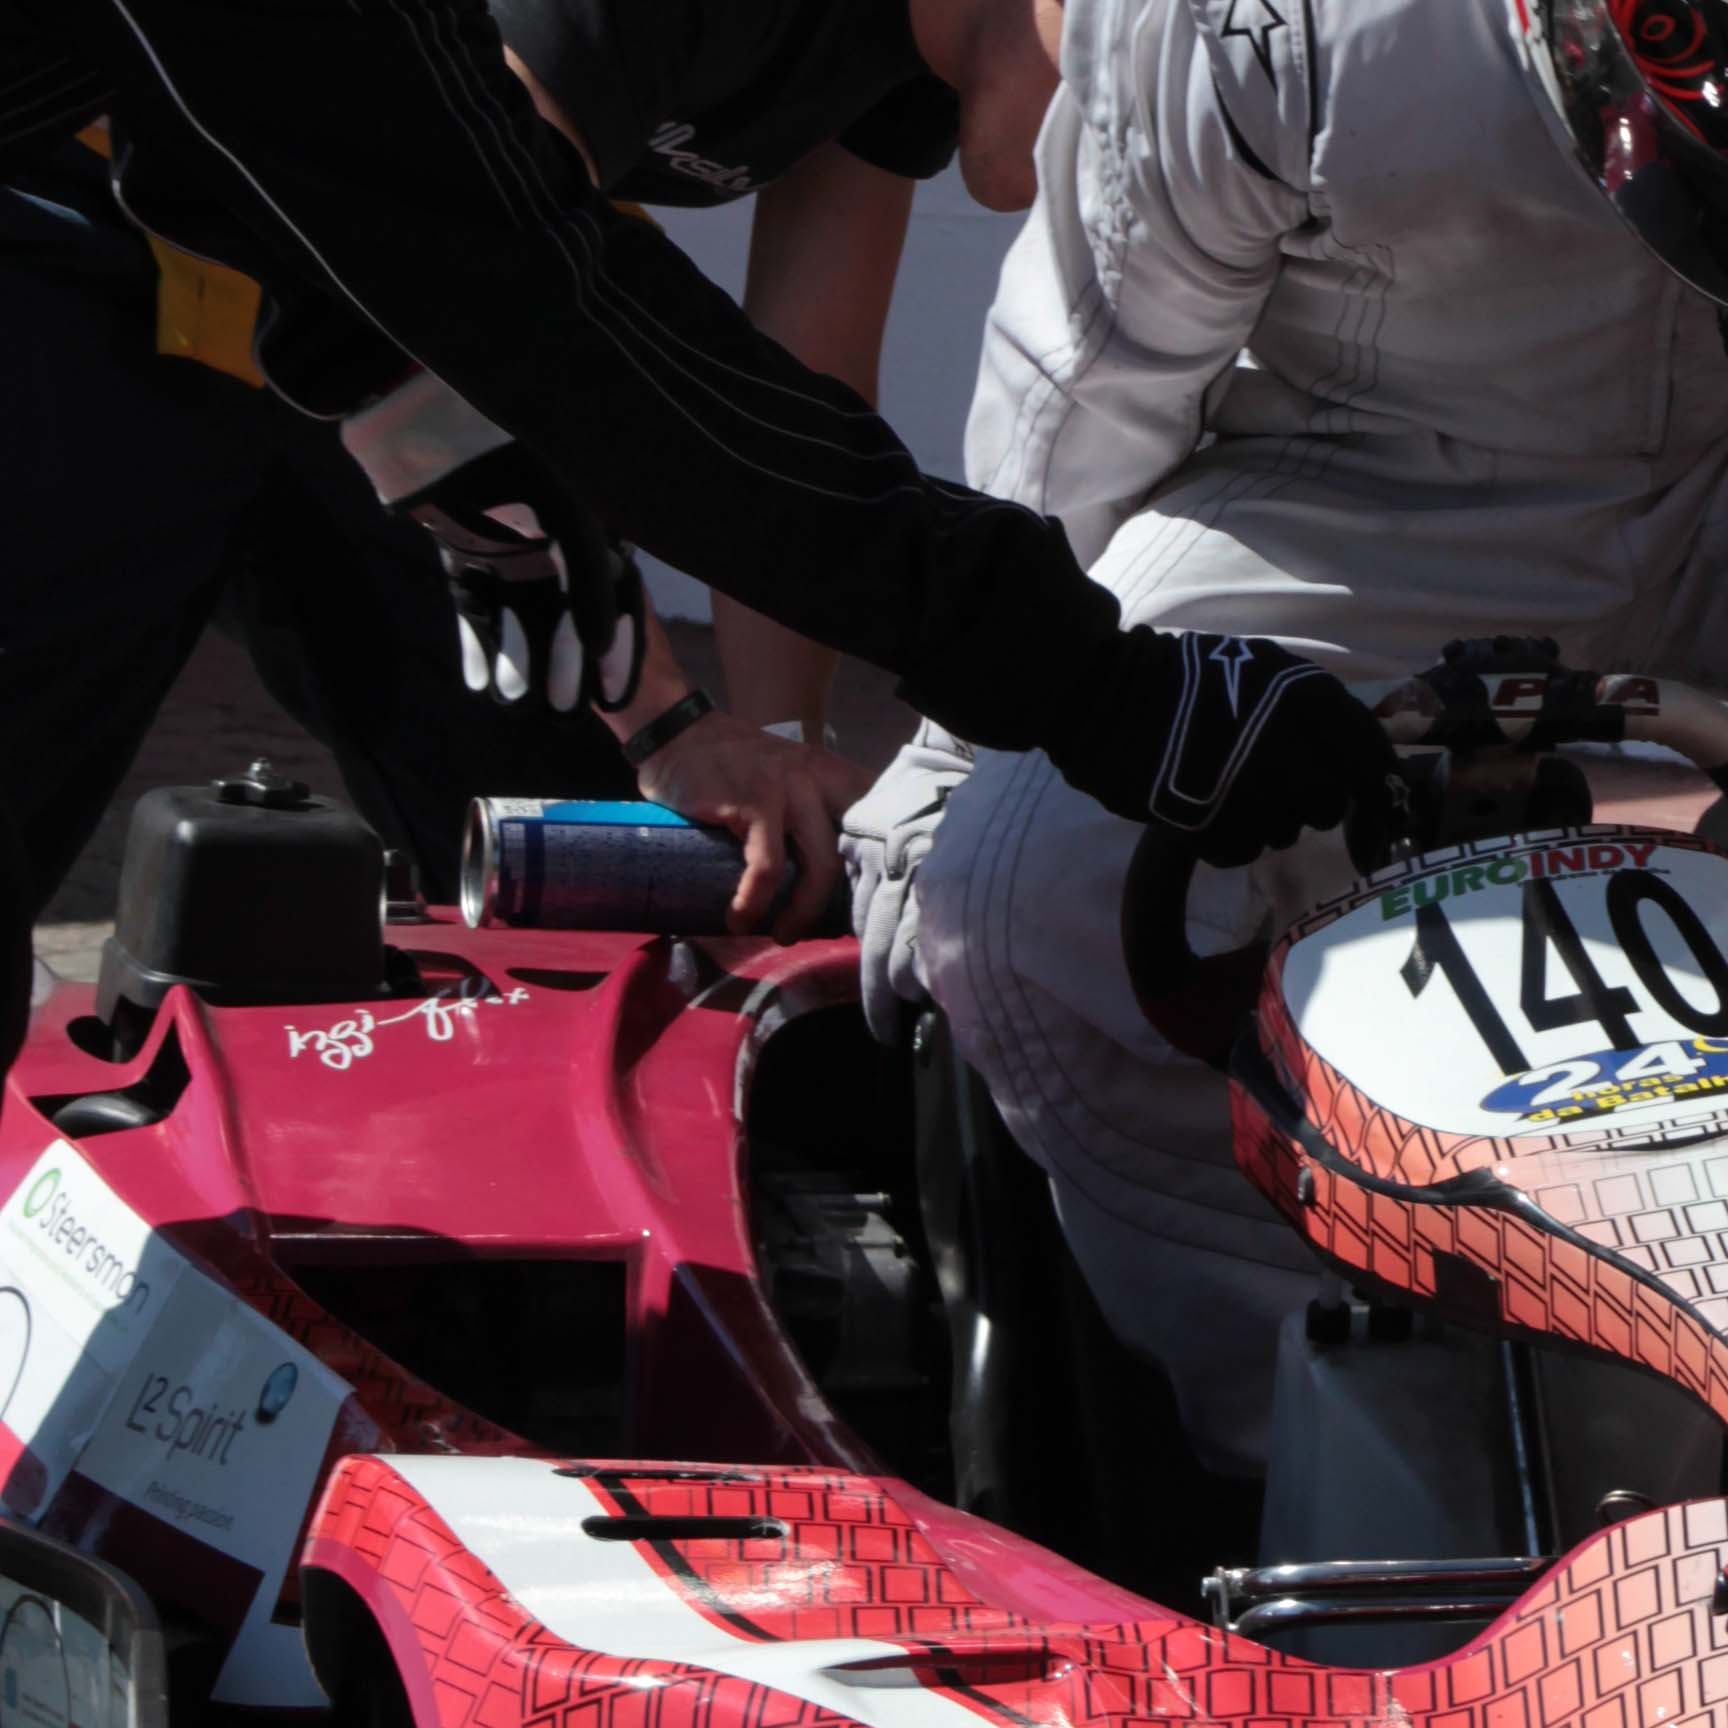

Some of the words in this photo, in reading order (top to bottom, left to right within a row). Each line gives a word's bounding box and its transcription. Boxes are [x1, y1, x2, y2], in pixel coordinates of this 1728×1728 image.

[1380, 842, 1657, 922] EUROINDY
[1518, 1040, 1707, 1107] 24
[1571, 1075, 1684, 1102] horas
[1527, 1096, 1584, 1123] da
[155, 1384, 247, 1466] Spirit
